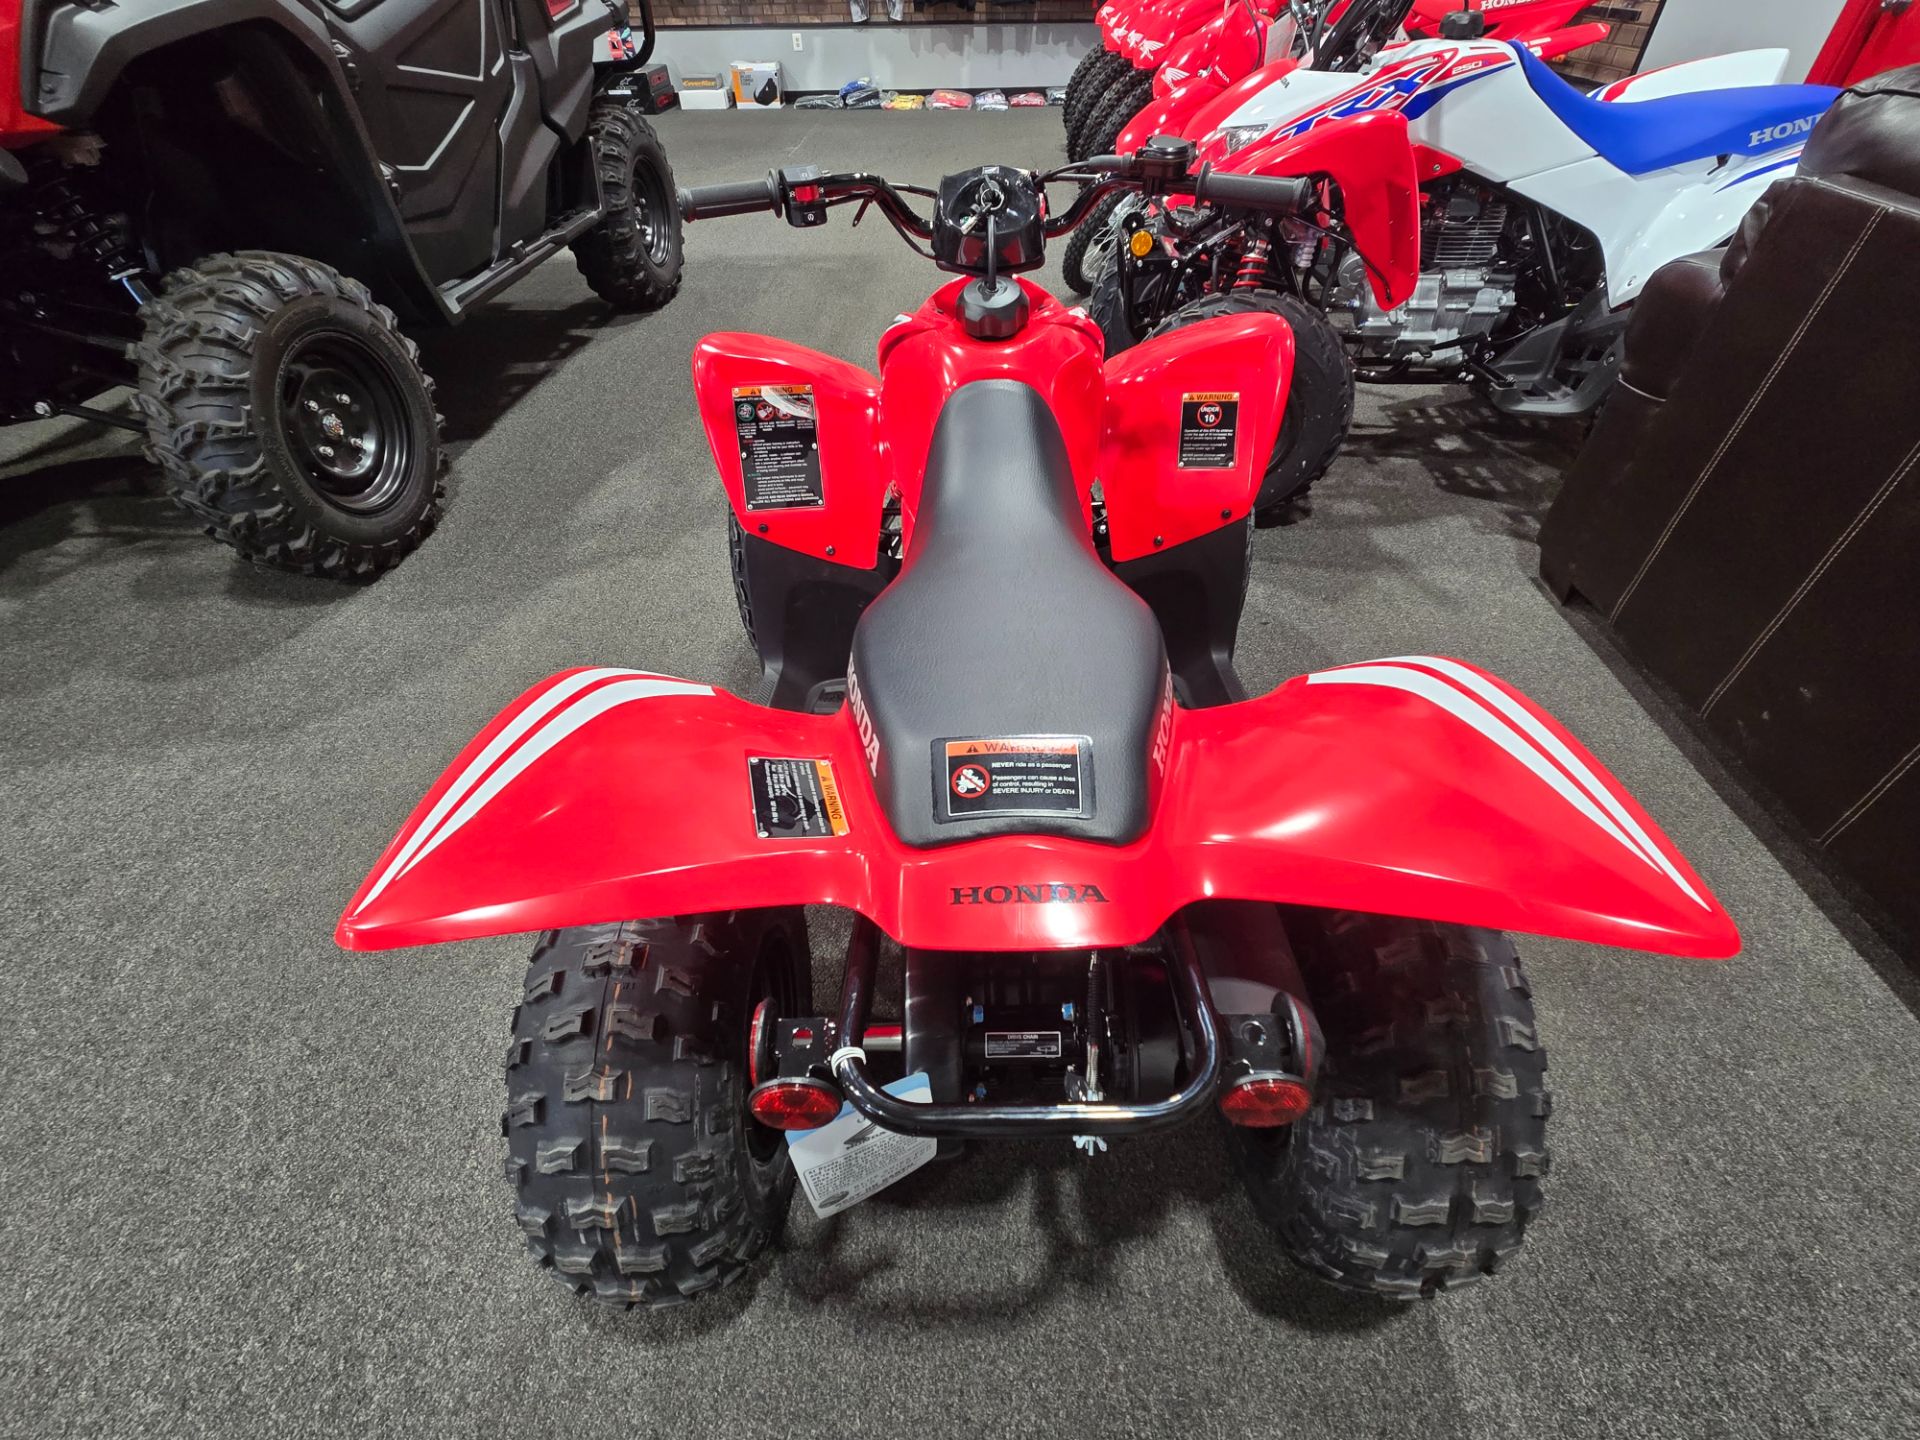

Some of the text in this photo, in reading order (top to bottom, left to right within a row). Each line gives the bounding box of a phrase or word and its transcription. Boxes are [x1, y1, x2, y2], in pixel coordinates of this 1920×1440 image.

[1480, 0, 1541, 11] HON
[1747, 112, 1825, 148] HON
[1196, 393, 1233, 401] WARNING
[1204, 414, 1216, 423] 10
[846, 651, 880, 778] HONDA
[824, 783, 843, 821] WARNING
[949, 883, 1110, 905] HONDA
